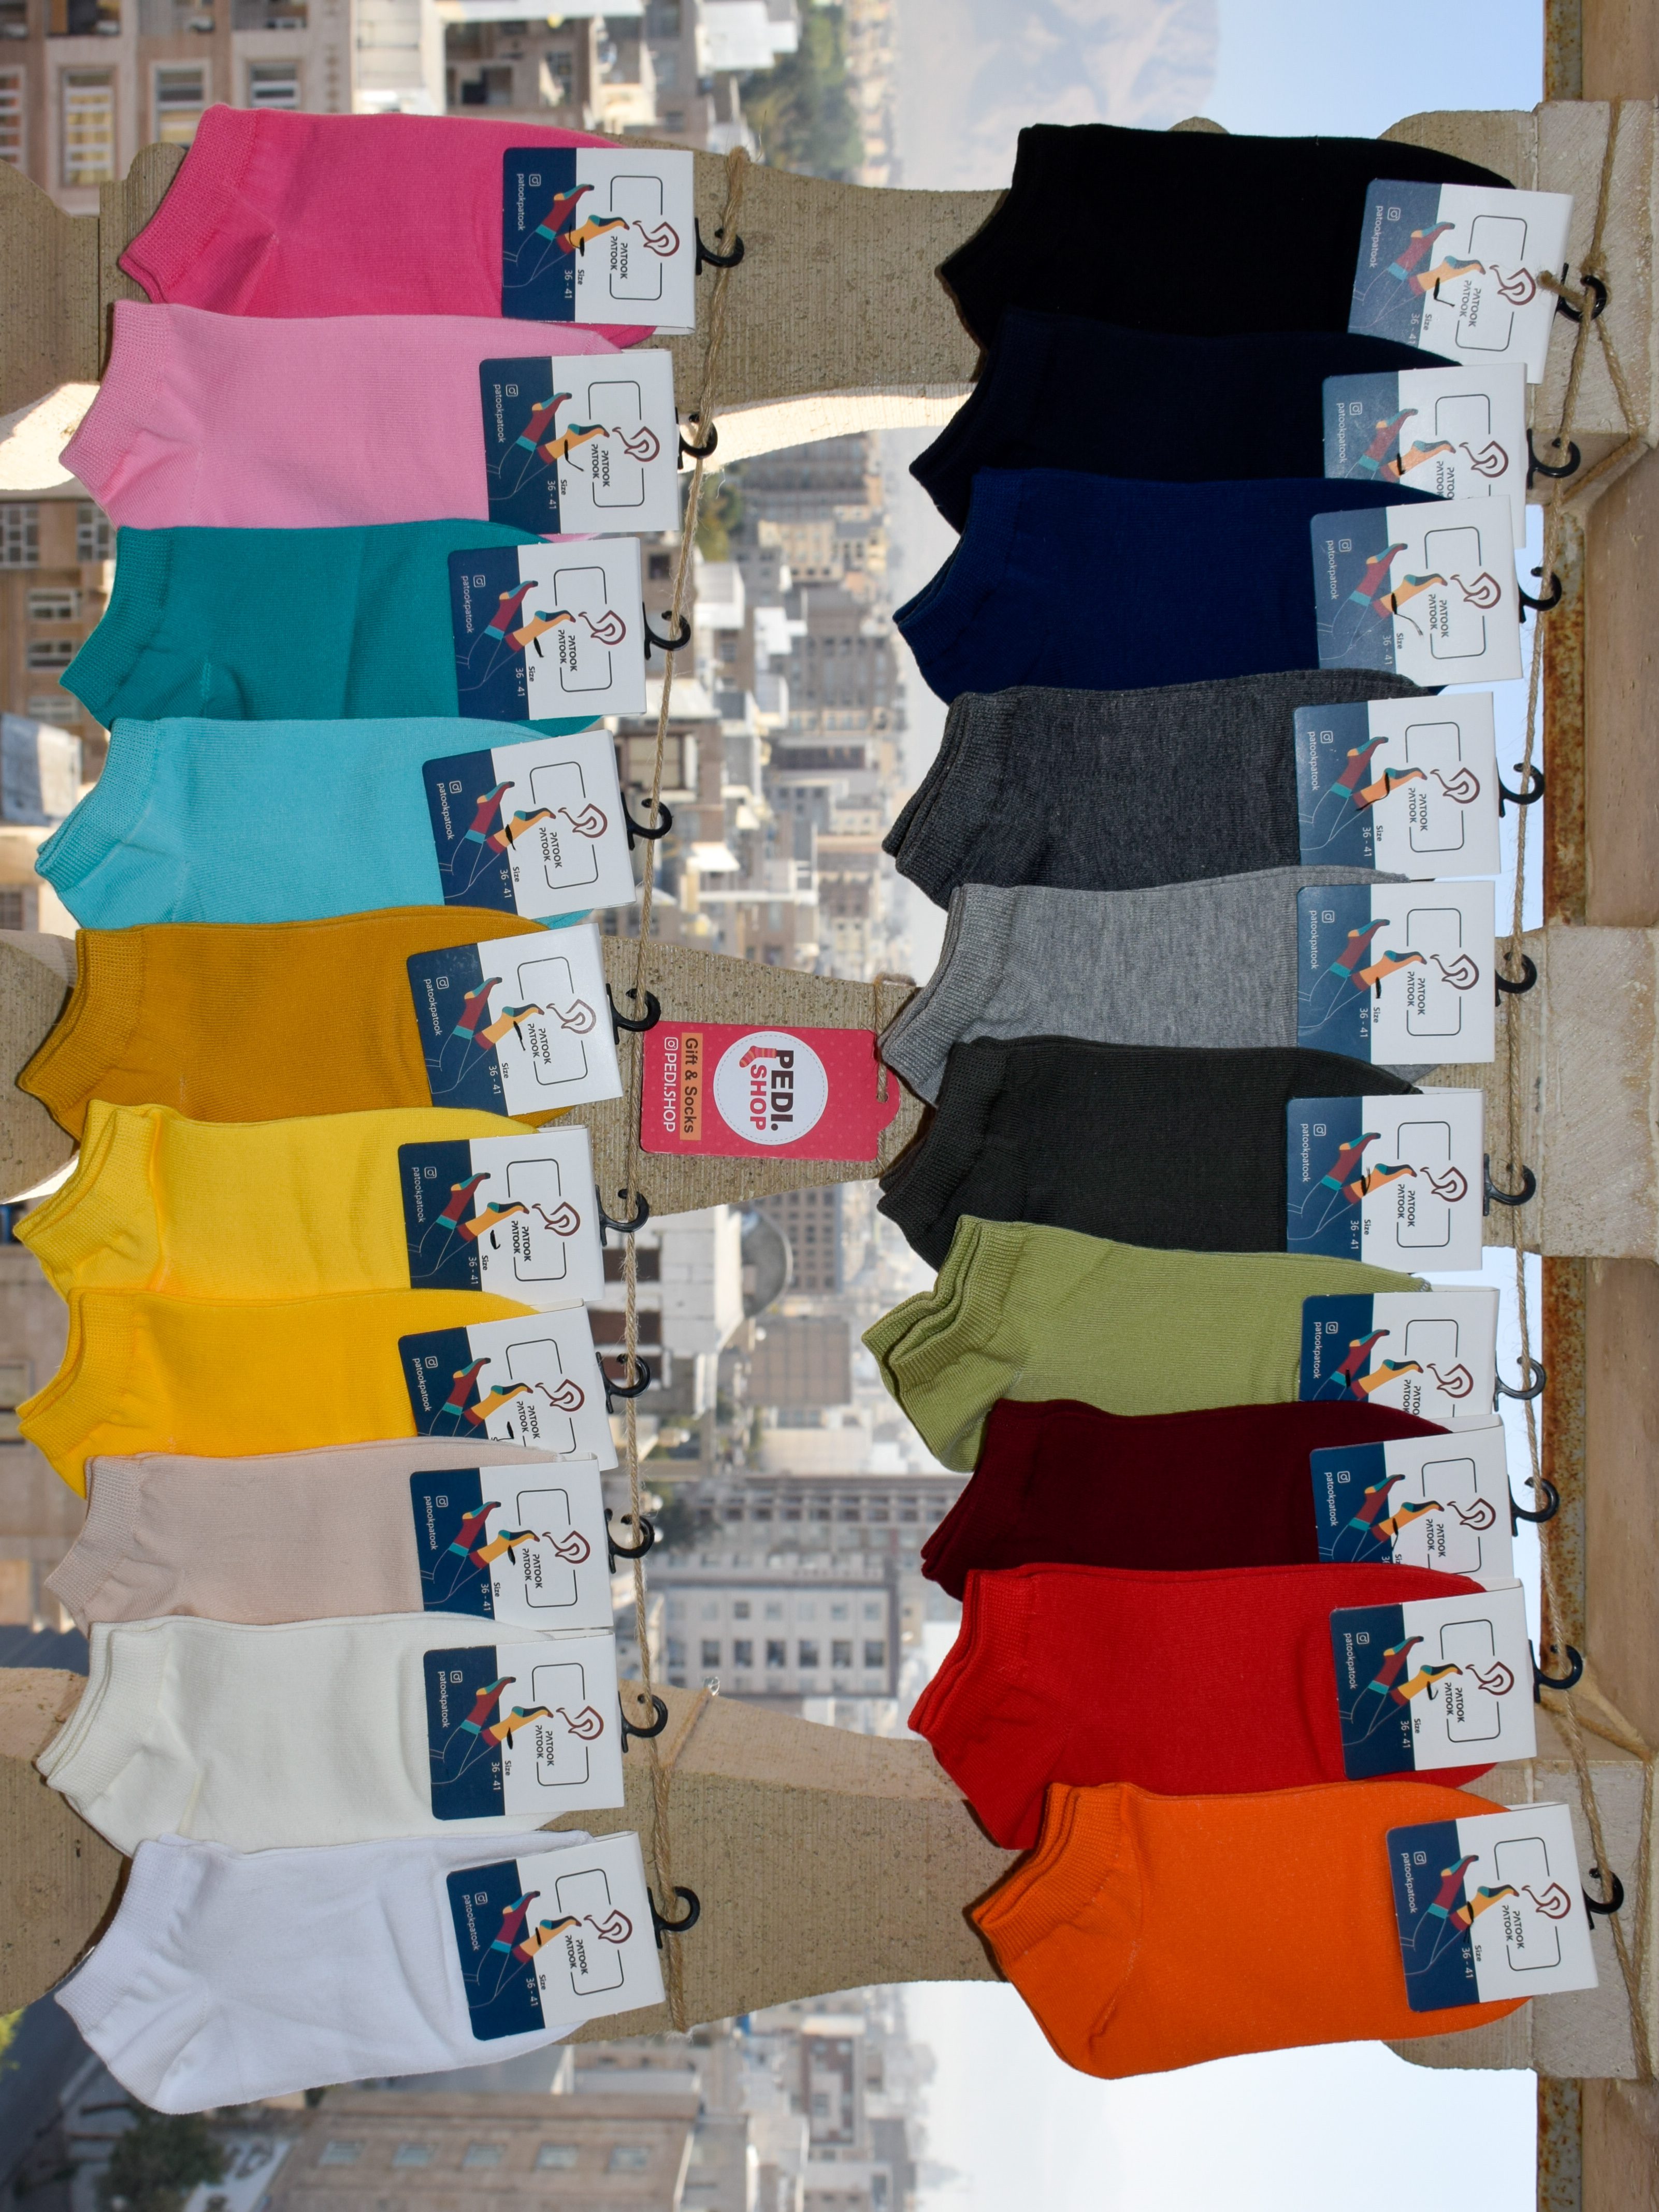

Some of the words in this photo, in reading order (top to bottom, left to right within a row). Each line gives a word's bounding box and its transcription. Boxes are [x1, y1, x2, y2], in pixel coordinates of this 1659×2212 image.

[516, 174, 526, 230] patookpatook
[1369, 205, 1383, 268] patookpatook
[565, 270, 572, 280] 36
[565, 288, 572, 298] 41
[1459, 280, 1472, 317] PATOOK
[1468, 288, 1482, 327] PATOOK
[1410, 313, 1420, 325] 36
[1423, 313, 1432, 331] Size
[1408, 332, 1417, 344] 41
[493, 384, 506, 443] patookpatook
[1336, 402, 1347, 464] patookpatook
[591, 443, 600, 479] PATOOK
[601, 450, 610, 487] PATOOK
[547, 480, 556, 491] 36
[1447, 467, 1455, 500] PATOO
[549, 499, 557, 509] 41
[1325, 540, 1339, 600] patookpatook
[461, 576, 474, 633] patookpatook
[1429, 594, 1438, 630] PATOOK
[1439, 599, 1449, 638] PATOOK
[558, 629, 567, 664] PATOOK
[568, 635, 578, 672] PATOOK
[1382, 634, 1392, 646] 36
[515, 667, 524, 678] 36
[1384, 654, 1393, 664] 41
[517, 686, 525, 696] 41
[1307, 731, 1320, 791] patookpatook
[437, 783, 455, 840] patookpatook
[1408, 787, 1417, 823] PATOOK
[1419, 793, 1428, 831] PATOOK
[539, 827, 551, 862] PATOOK
[1362, 827, 1371, 838] 36
[550, 832, 562, 869] PATOOK
[1364, 846, 1372, 857] 41
[500, 869, 509, 880] 36
[503, 887, 512, 898] 41
[1309, 910, 1319, 970] patookpatook
[423, 978, 442, 1036] patookpatook
[1360, 1008, 1368, 1019] 36
[527, 1022, 540, 1058] PATOOK
[538, 1028, 552, 1065] PATOOK
[1360, 1027, 1368, 1037] 41
[685, 1037, 698, 1065] Gift
[488, 1065, 498, 1077] 36
[493, 1083, 501, 1094] 41
[501, 1062, 509, 1079] Size
[685, 1069, 698, 1080] &
[663, 1053, 677, 1132] PEDI.SHOP
[684, 1086, 698, 1133] Socks
[750, 1064, 767, 1131] SHOP
[1301, 1123, 1310, 1182] patookpatook
[411, 1166, 426, 1223] patookpatook
[1407, 1190, 1416, 1227] PATOOK
[511, 1220, 521, 1254] PATOOK
[1351, 1220, 1359, 1231] 36
[522, 1226, 531, 1262] PATOOK
[1351, 1239, 1359, 1249] 41
[468, 1256, 477, 1267] 36
[470, 1274, 479, 1284] 41
[1312, 1322, 1322, 1378] patookpatook
[412, 1358, 432, 1411] patookpatook
[1412, 1386, 1421, 1416] PATOO
[516, 1400, 529, 1433] PATOOK
[527, 1405, 541, 1439] PATOOK
[1324, 1472, 1338, 1526] patookpatook
[423, 1496, 438, 1550] patookpatook
[1426, 1518, 1435, 1551] PATOOK
[1436, 1523, 1446, 1557] PATOOK
[522, 1548, 532, 1581] PATOOK
[532, 1554, 543, 1588] PATOOK
[481, 1583, 489, 1594] 36
[483, 1601, 492, 1611] 41
[1343, 1633, 1358, 1689] patookpatook
[437, 1671, 450, 1728] patookpatook
[1445, 1682, 1454, 1716] PATOOK
[1455, 1687, 1465, 1723] PATOOK
[535, 1725, 544, 1759] PATOOK
[1401, 1720, 1409, 1731] 36
[1403, 1738, 1411, 1747] 41
[545, 1730, 555, 1767] PATOOK
[492, 1761, 500, 1772] 36
[493, 1780, 501, 1790] 41
[1401, 1853, 1418, 1913] patookpatook
[462, 1894, 481, 1950] patookpatook
[1502, 1904, 1513, 1942] PATOOK
[1512, 1911, 1525, 1949] PATOOK
[565, 1934, 578, 1969] PATOOK
[575, 1939, 589, 1975] PATOOK
[1462, 1947, 1471, 1959] 36
[526, 1977, 535, 1989] 36
[1465, 1967, 1474, 1978] 41
[529, 1996, 539, 2006] 41
